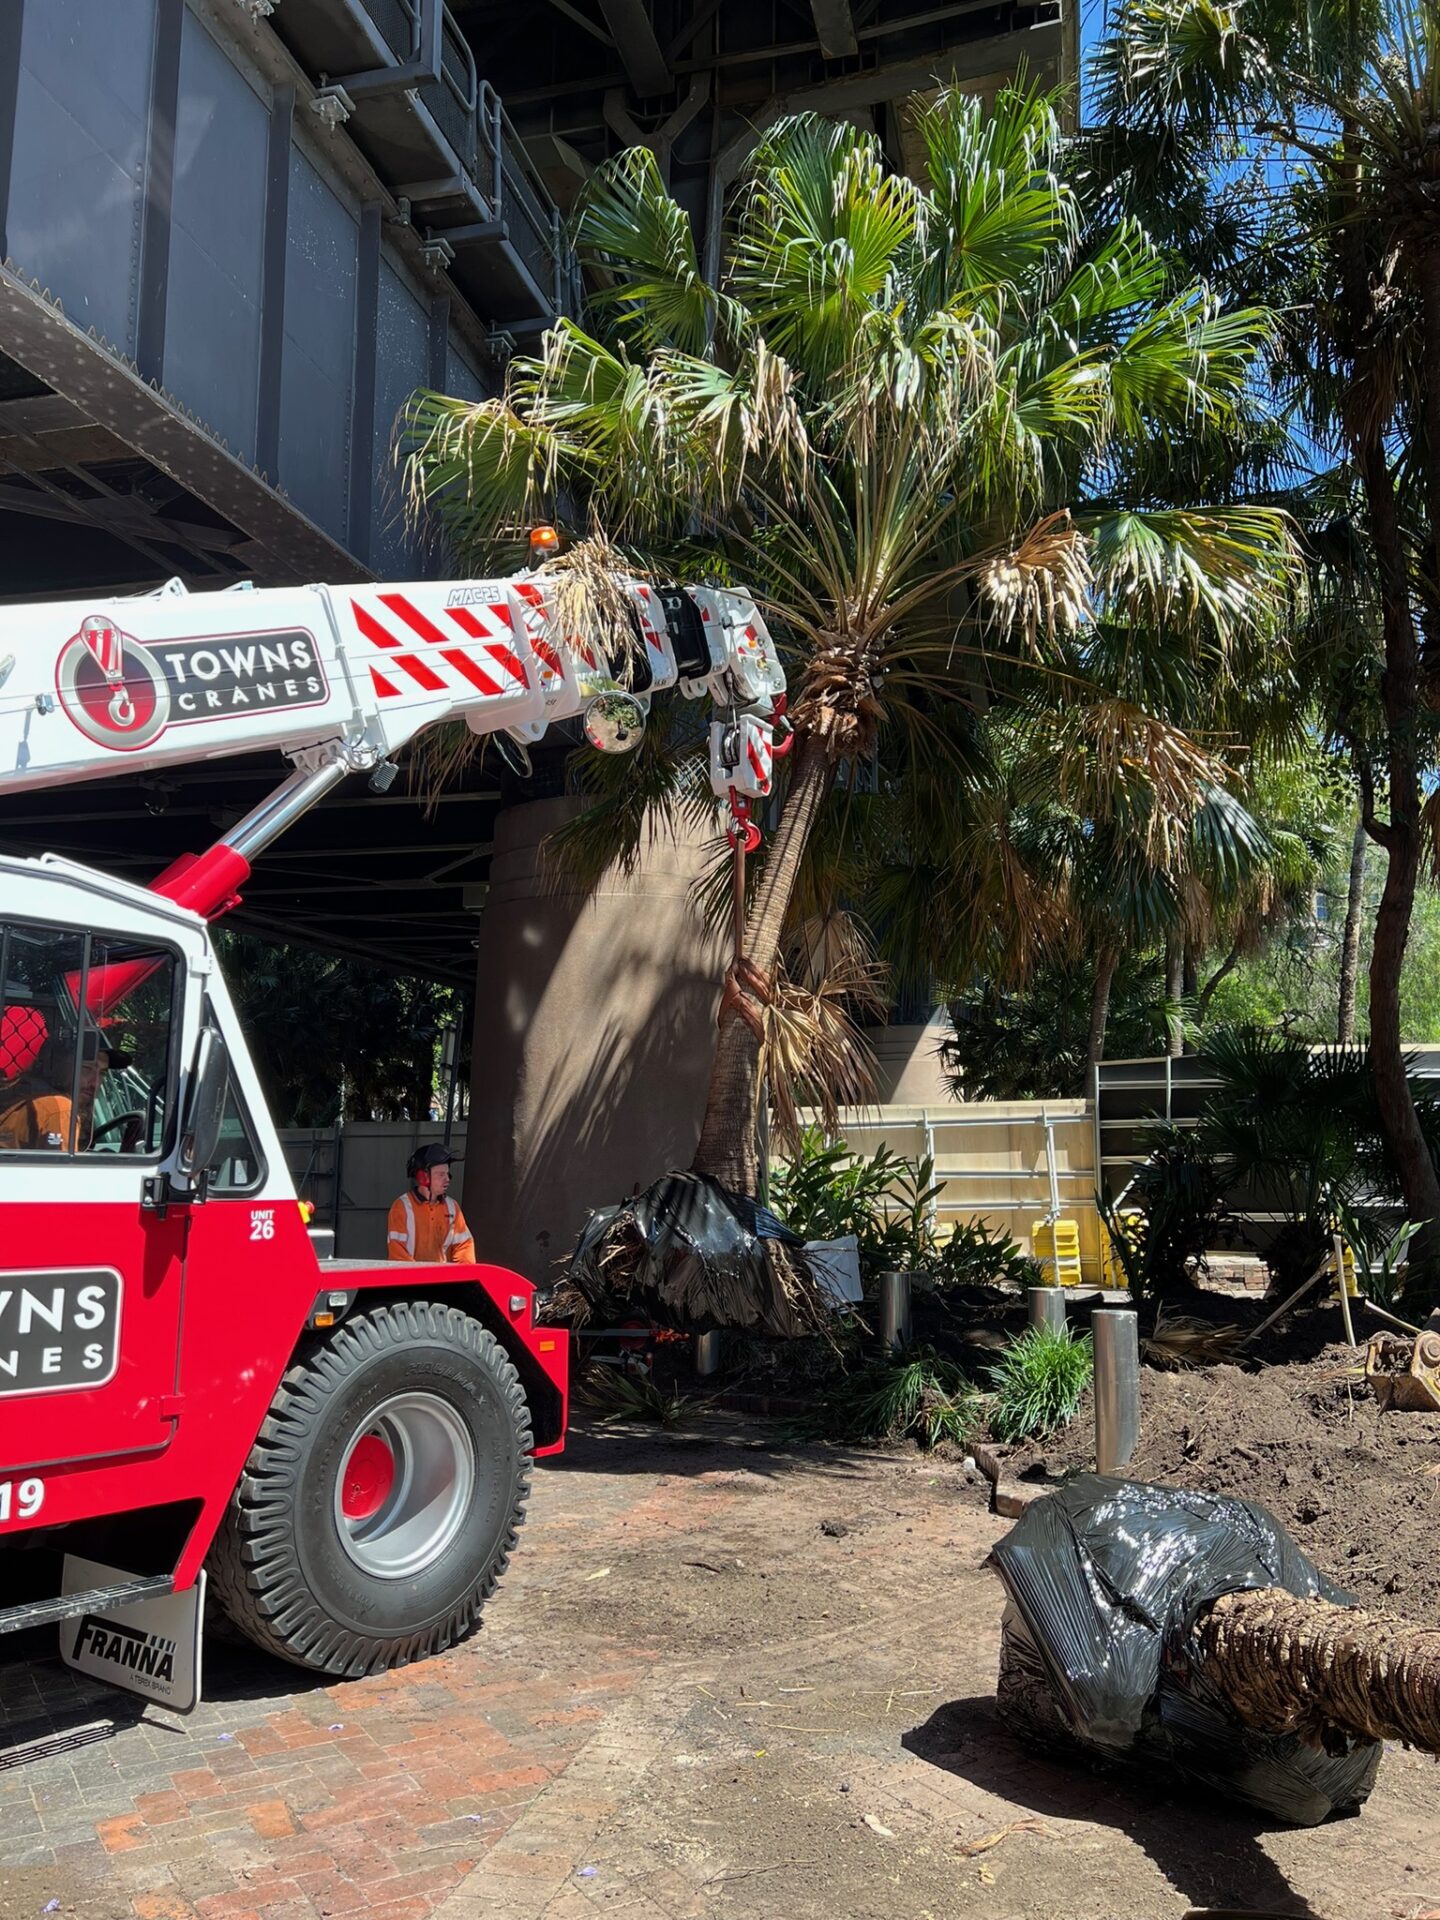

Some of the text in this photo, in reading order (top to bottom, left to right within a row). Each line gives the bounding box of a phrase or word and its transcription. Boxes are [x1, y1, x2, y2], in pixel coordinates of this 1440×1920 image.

[165, 640, 311, 683] TOWNS
[178, 676, 320, 711] CRANES
[250, 1209, 275, 1220] UNIT
[250, 1220, 275, 1240] 26
[0, 1285, 106, 1334] NS
[0, 1477, 45, 1520] 19
[72, 1614, 174, 1682] FRANNA
